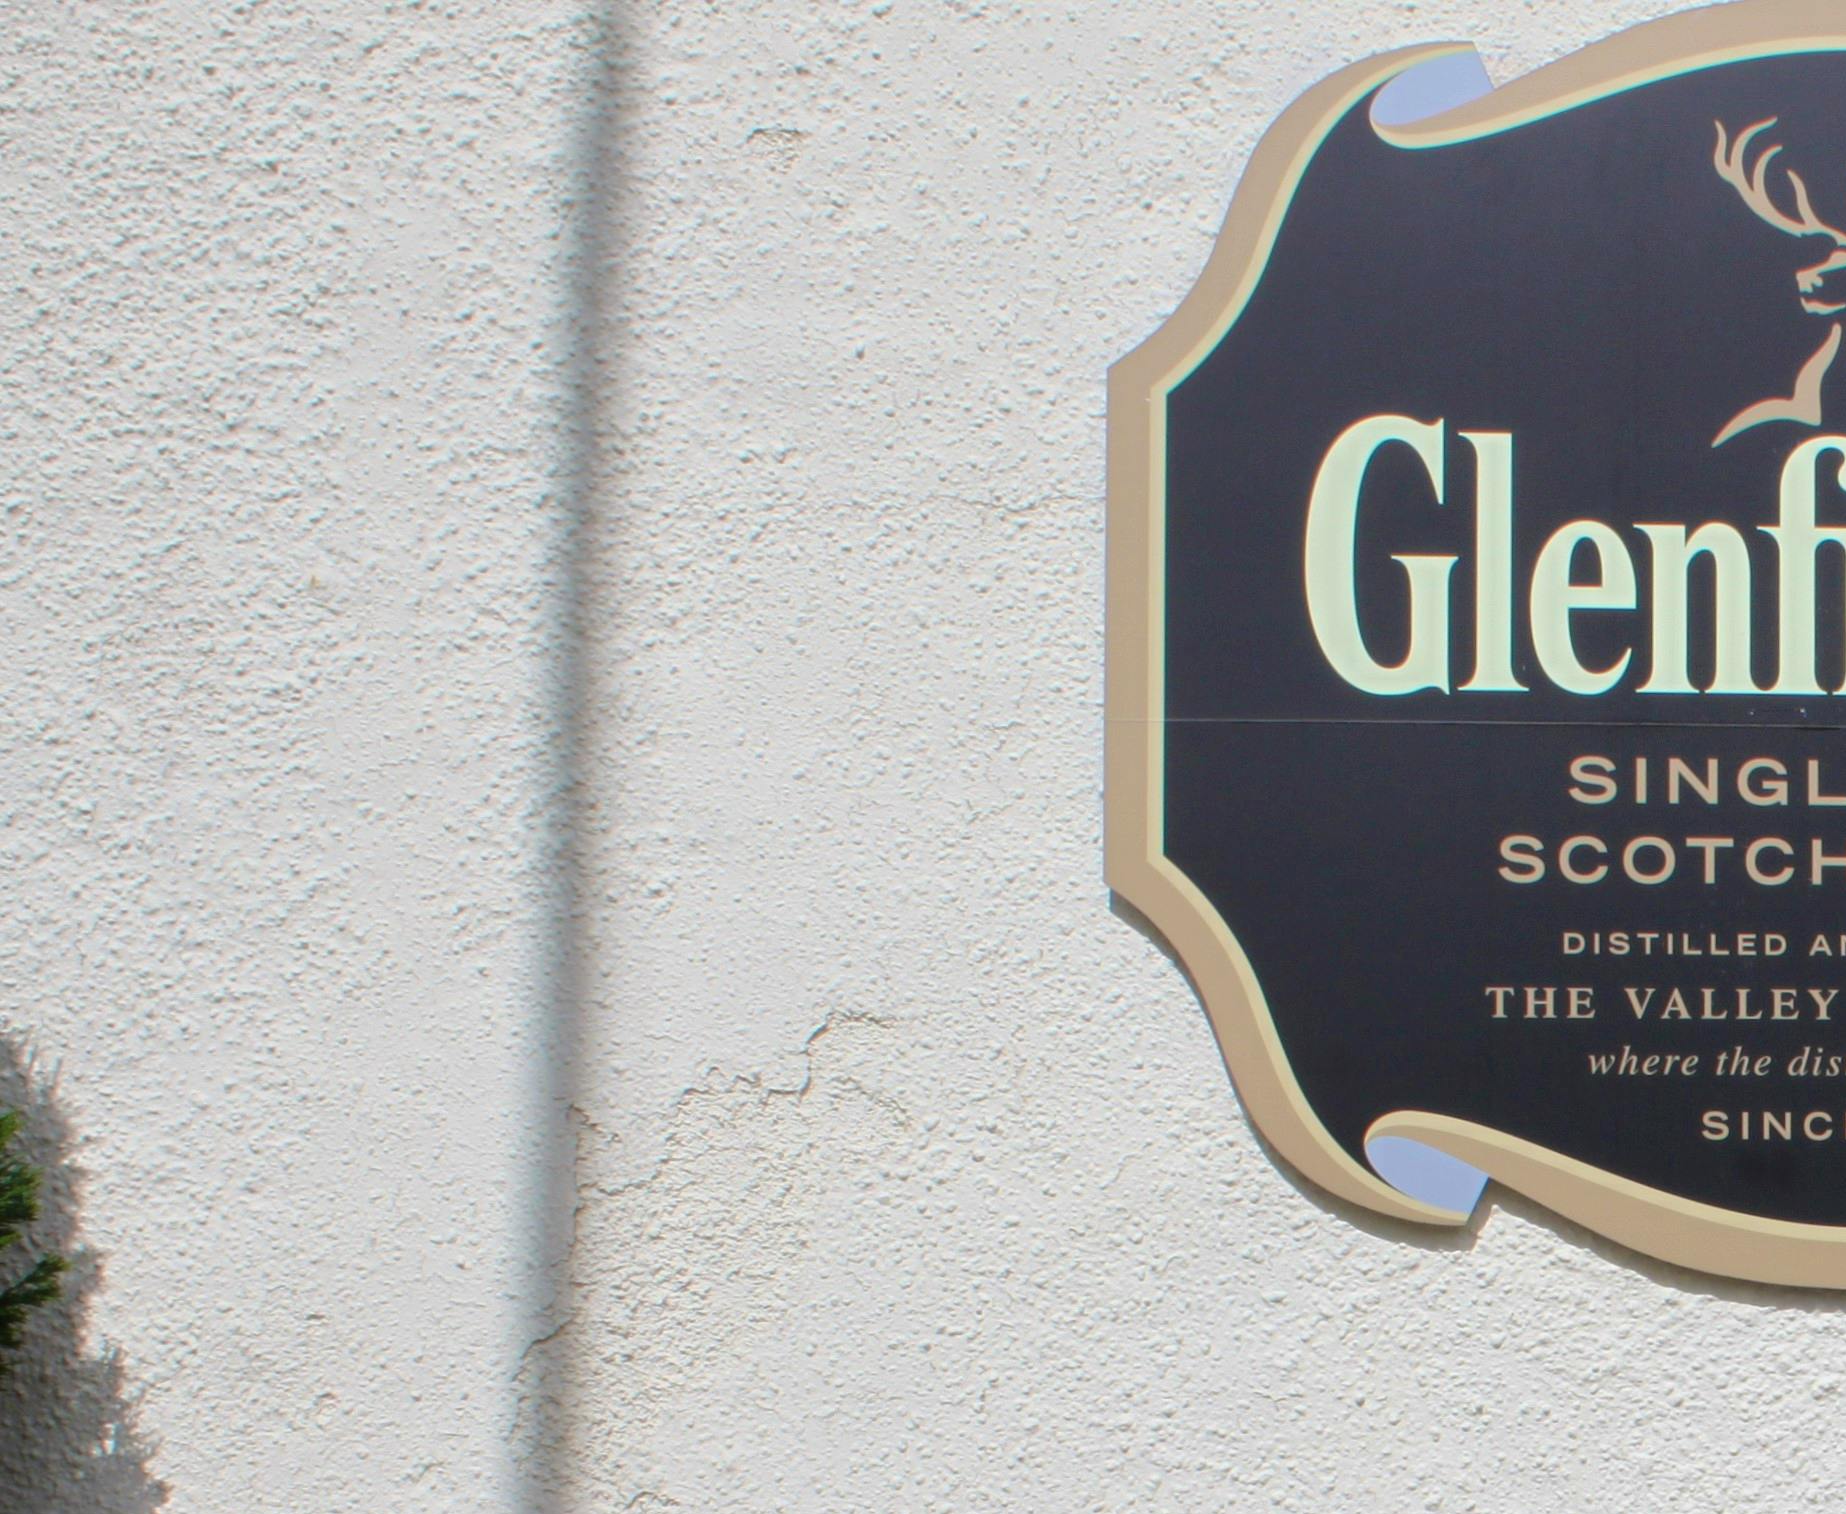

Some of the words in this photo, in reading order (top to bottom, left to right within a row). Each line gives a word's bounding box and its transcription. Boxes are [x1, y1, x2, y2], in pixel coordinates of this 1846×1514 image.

[1563, 932, 1787, 956] DISTILLED
[1485, 986, 1596, 1019] THE
[1624, 987, 1839, 1020] VALLEY
[1589, 1045, 1699, 1076] where
[1716, 1045, 1772, 1076] the
